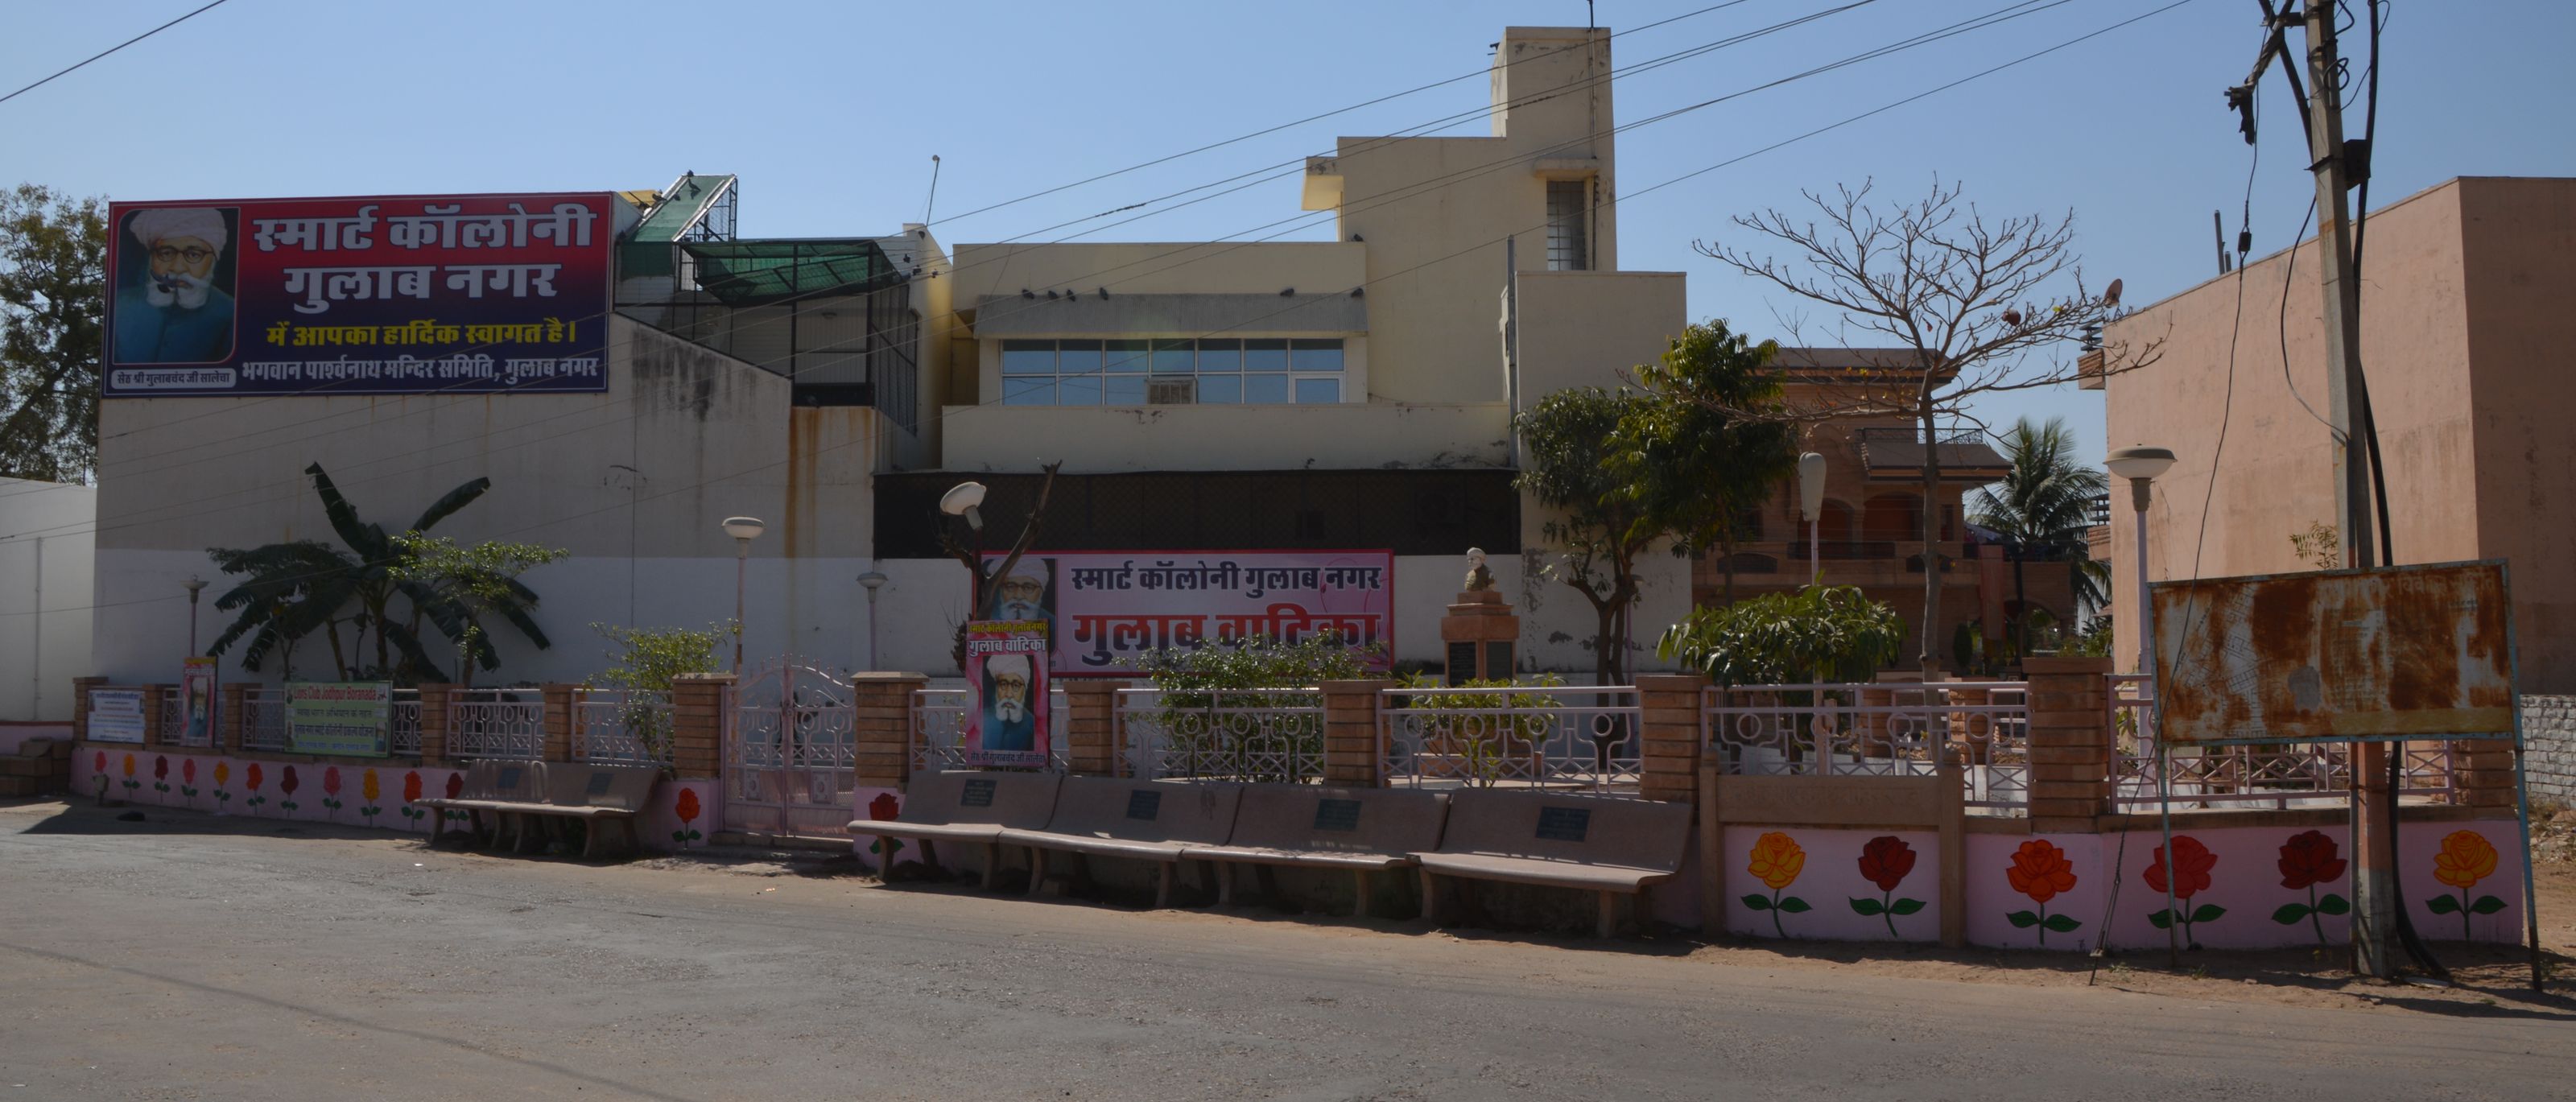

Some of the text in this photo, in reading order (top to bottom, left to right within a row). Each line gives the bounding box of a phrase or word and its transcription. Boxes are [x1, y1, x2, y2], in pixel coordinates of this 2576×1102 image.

[252, 202, 598, 252] स्मार्ट कॉलोनी
[283, 263, 562, 314] गुलाब नगर
[266, 320, 290, 346] में
[293, 326, 379, 346] आपका
[382, 319, 460, 345] हार्दिक
[464, 324, 543, 344] स्वागत
[133, 371, 144, 384] श्री
[186, 371, 198, 383] जी
[242, 361, 303, 380] भगवान
[385, 353, 436, 379] मन्दिर
[505, 358, 557, 385] गुलाब
[559, 358, 599, 378] नगर
[1071, 560, 1381, 599] स्मार्ट कॉलोनी गुलाब नगर
[969, 636, 1047, 657] गुलाब वाटिका
[1072, 602, 1381, 667] गुलाब वाटिका
